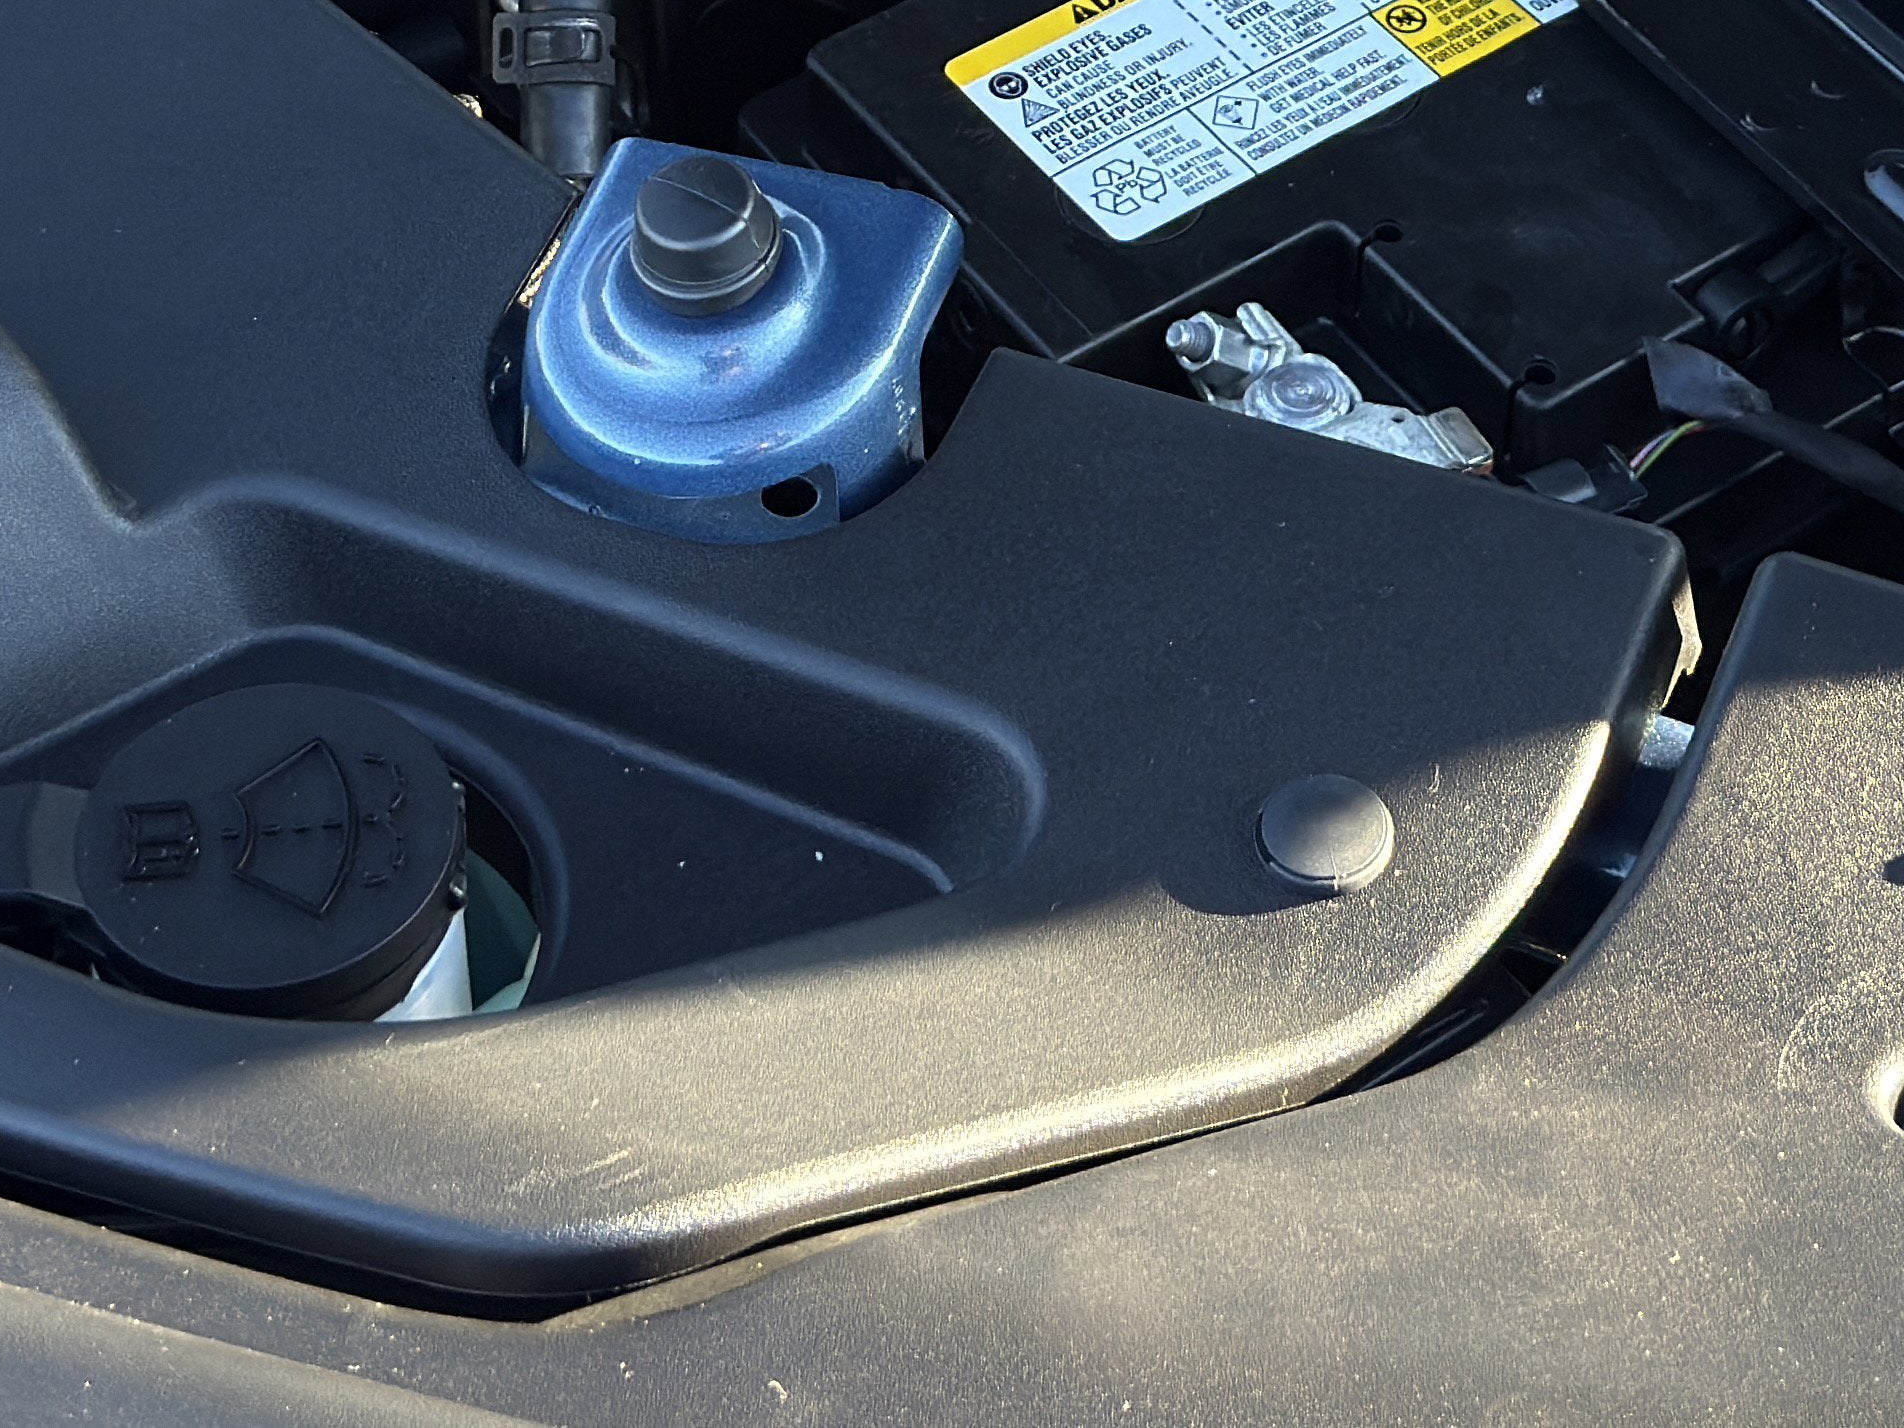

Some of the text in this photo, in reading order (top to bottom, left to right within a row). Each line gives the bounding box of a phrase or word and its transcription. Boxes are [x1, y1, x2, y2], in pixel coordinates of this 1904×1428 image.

[1224, 0, 1276, 31] ÉVITER
[1256, 1, 1337, 47] LES FLAMMES
[1424, 0, 1449, 15] THE
[1437, 12, 1453, 26] OF
[1245, 20, 1272, 38] LES
[1266, 21, 1328, 56] DE FUMER
[1414, 7, 1501, 56] TENIR HORS DE LA
[1462, 34, 1482, 48] DE
[1475, 12, 1525, 41] ENFANTS.
[1021, 30, 1112, 78] SHIELD EYES.
[1032, 23, 1152, 89] EXPLOSIVE GASES
[1245, 24, 1368, 92] FLUSH EYES IMMEDIATELY
[1045, 59, 1115, 99] CAN CAUSE
[1056, 37, 1193, 112] BLINDNESS OR INJURY.
[1256, 66, 1325, 103] WITH WATER.
[1269, 49, 1387, 114] GET MEDICAL HELP FAST.
[1030, 68, 1171, 143] PROTÉGEZ LES YEUX.
[1042, 55, 1226, 155] LES GAZ EXPLOSIFS PEUVENT
[1054, 67, 1239, 165] BLESSER OU RENDRE AVEUGLE.
[1133, 124, 1177, 150] BATTERY
[1142, 133, 1186, 159] MUST BE
[1233, 127, 1271, 151] RINCEZ
[1265, 119, 1288, 134] LES
[1282, 107, 1311, 124] YEUX
[1246, 128, 1301, 161] CONSULTEZ
[1294, 122, 1314, 136] UN
[1151, 138, 1202, 167] RECYCLED
[1164, 146, 1225, 180] LA BATTERIE
[1114, 179, 1141, 194] Pb
[1172, 170, 1198, 189] DOIT
